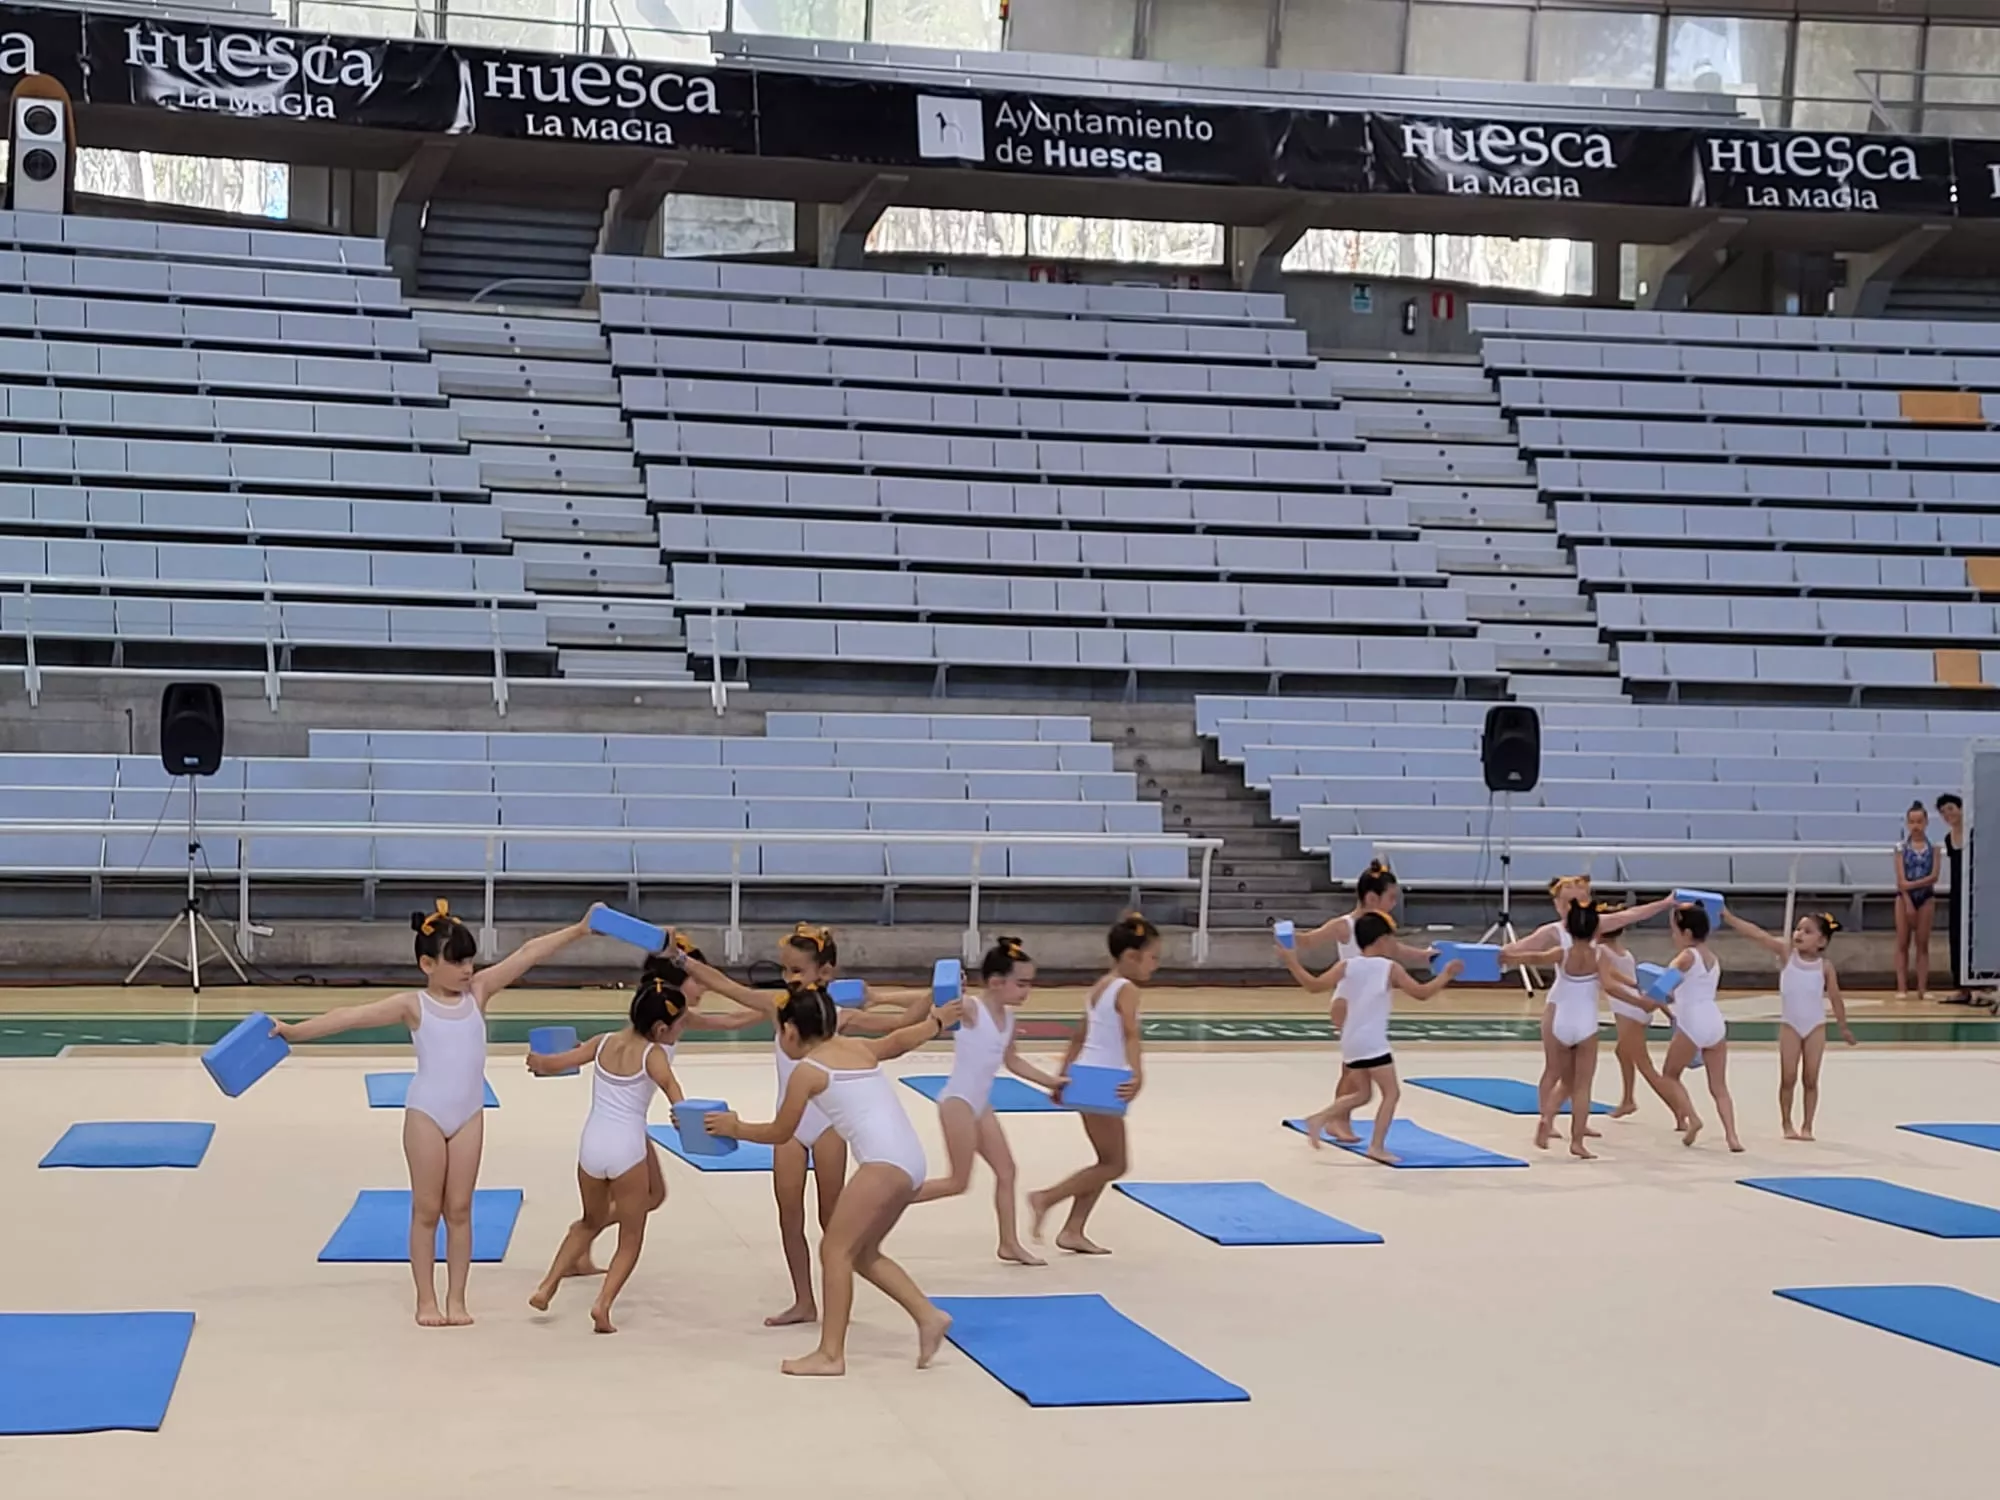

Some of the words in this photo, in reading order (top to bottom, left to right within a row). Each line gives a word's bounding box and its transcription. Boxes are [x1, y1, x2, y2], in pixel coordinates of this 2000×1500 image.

[124, 25, 376, 87] Huesca
[179, 86, 218, 109] La
[483, 61, 721, 115] Huesca
[526, 113, 564, 136] La
[995, 100, 1213, 142] Ayuntamiento
[996, 137, 1033, 164] de
[1043, 139, 1163, 173] Huesca
[1400, 123, 1618, 169] Huesca
[1707, 135, 1922, 181] Huesca
[1447, 172, 1480, 194] La
[1746, 186, 1780, 206] La
